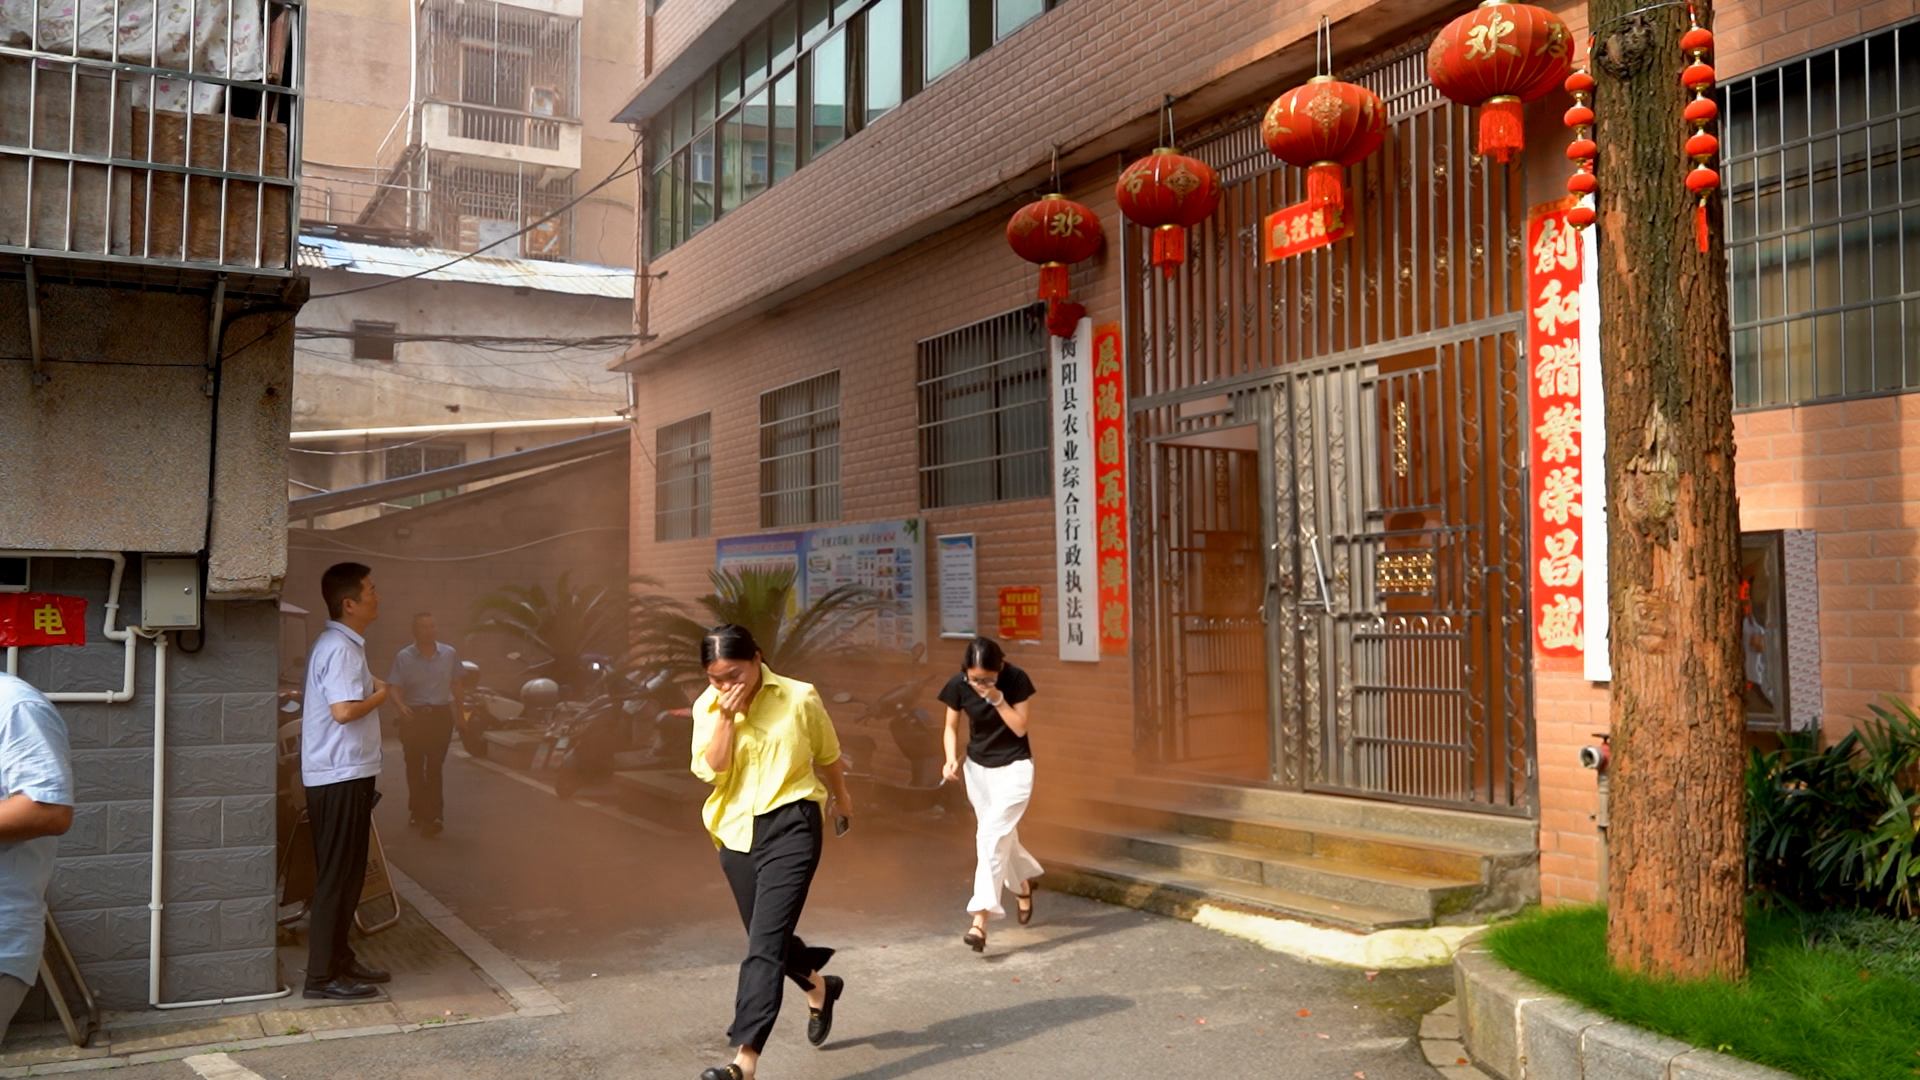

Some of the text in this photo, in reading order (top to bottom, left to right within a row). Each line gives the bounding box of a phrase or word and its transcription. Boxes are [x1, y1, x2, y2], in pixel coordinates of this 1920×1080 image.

[1050, 206, 1085, 240] 欢
[1060, 334, 1085, 647] 衡阳县农业综合行政执法局
[33, 603, 67, 635] 电
